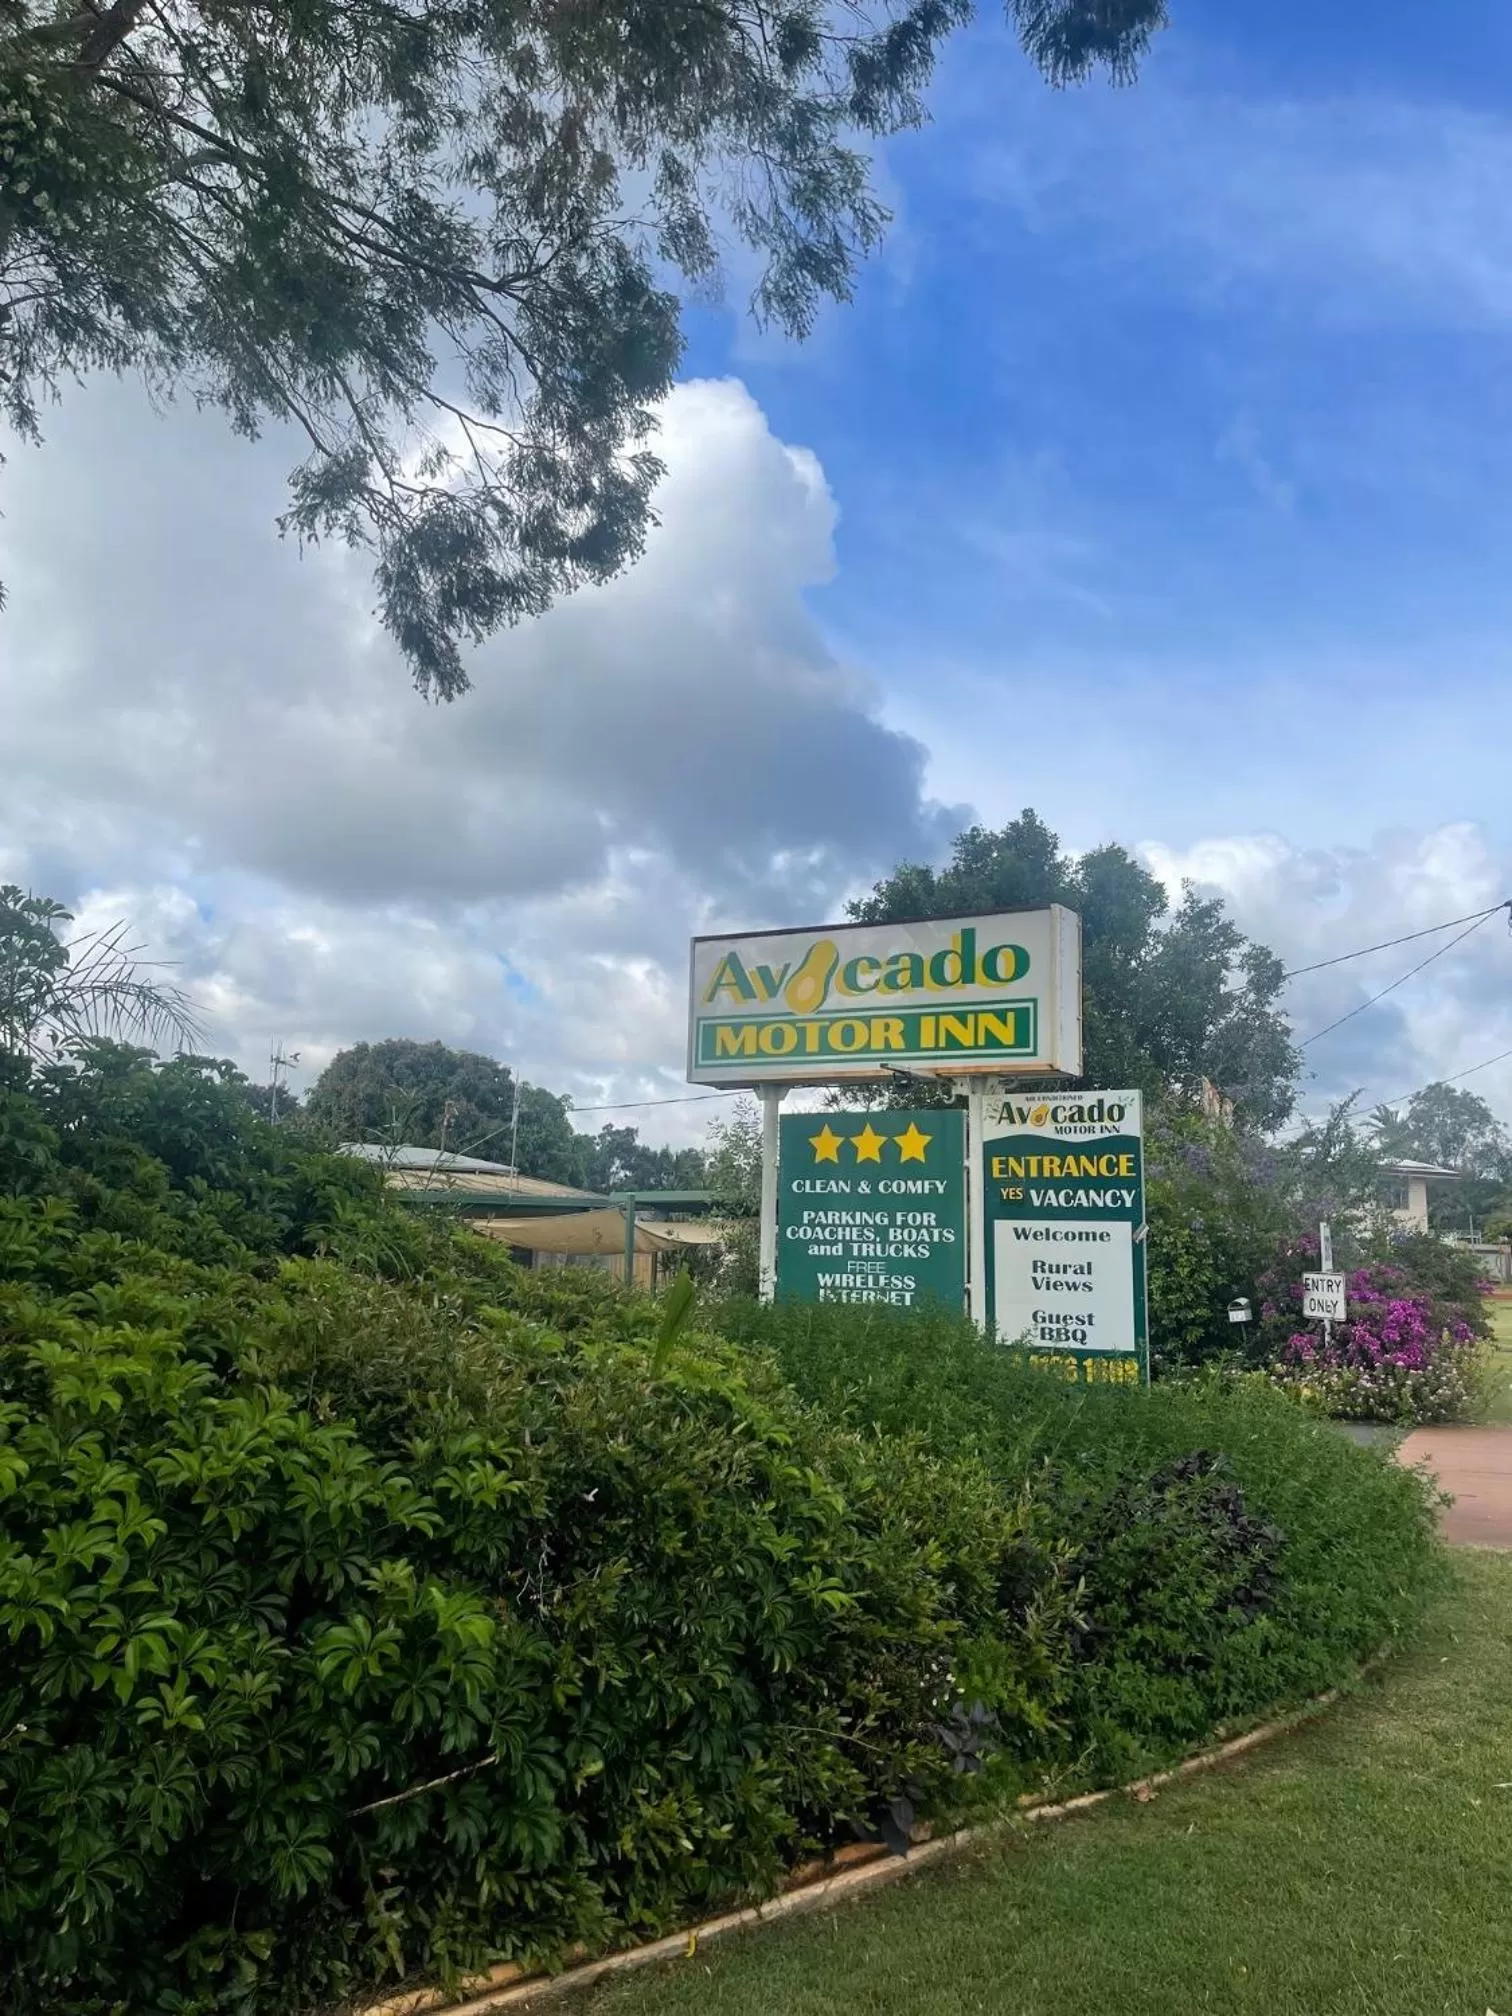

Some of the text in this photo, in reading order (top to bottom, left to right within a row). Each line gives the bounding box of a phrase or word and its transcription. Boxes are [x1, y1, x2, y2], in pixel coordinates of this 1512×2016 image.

[715, 1011, 1015, 1056] MOTOR INN
[1054, 1125, 1121, 1135] MOTOR INN
[991, 1154, 1136, 1178] ENTRANCE
[791, 1179, 947, 1194] CLEAN & COMFY
[1000, 1187, 1136, 1208] YES VACANCY
[802, 1211, 936, 1226] PARKING FOR
[889, 1228, 955, 1243] BOATS
[1013, 1227, 1111, 1242] Welcome
[808, 1243, 930, 1258] and TRUCKS
[847, 1260, 887, 1274] FREE
[1031, 1260, 1093, 1275] Rural
[817, 1273, 916, 1289] WIRELESS
[1031, 1276, 1094, 1292] Views
[1304, 1278, 1342, 1293] ENTRY
[1309, 1298, 1338, 1314] ONLY
[1032, 1309, 1096, 1326] Guest
[1039, 1327, 1088, 1345] BBQ
